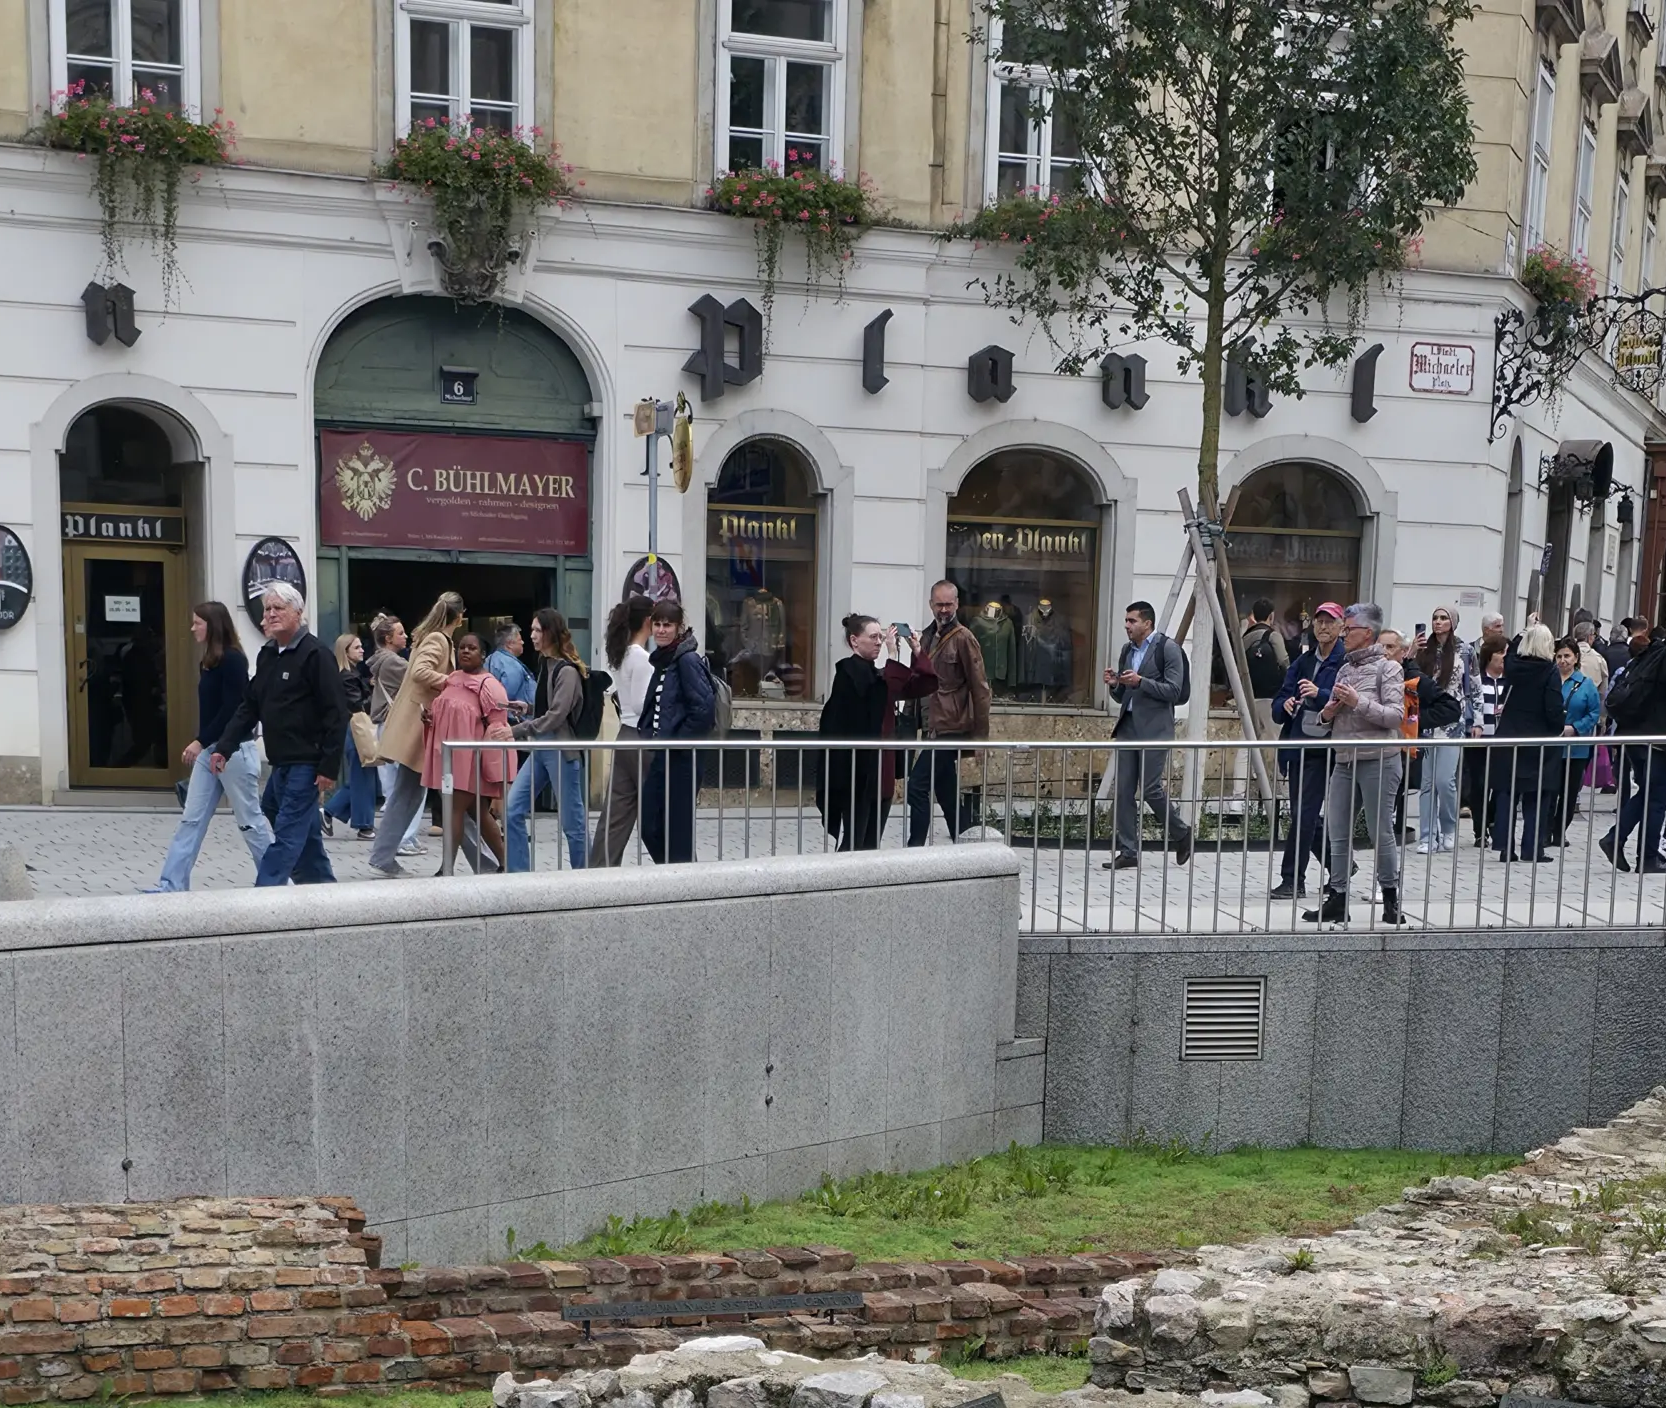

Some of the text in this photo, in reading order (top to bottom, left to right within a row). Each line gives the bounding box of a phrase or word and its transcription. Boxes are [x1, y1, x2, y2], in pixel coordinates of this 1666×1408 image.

[1414, 354, 1472, 376] Michaeler
[454, 381, 464, 395] 6
[407, 465, 575, 498] C. BÜHLMAYER
[426, 498, 471, 507] vergolden
[478, 499, 513, 508] rahmen
[520, 500, 560, 511] designen
[65, 514, 162, 539] Plankl
